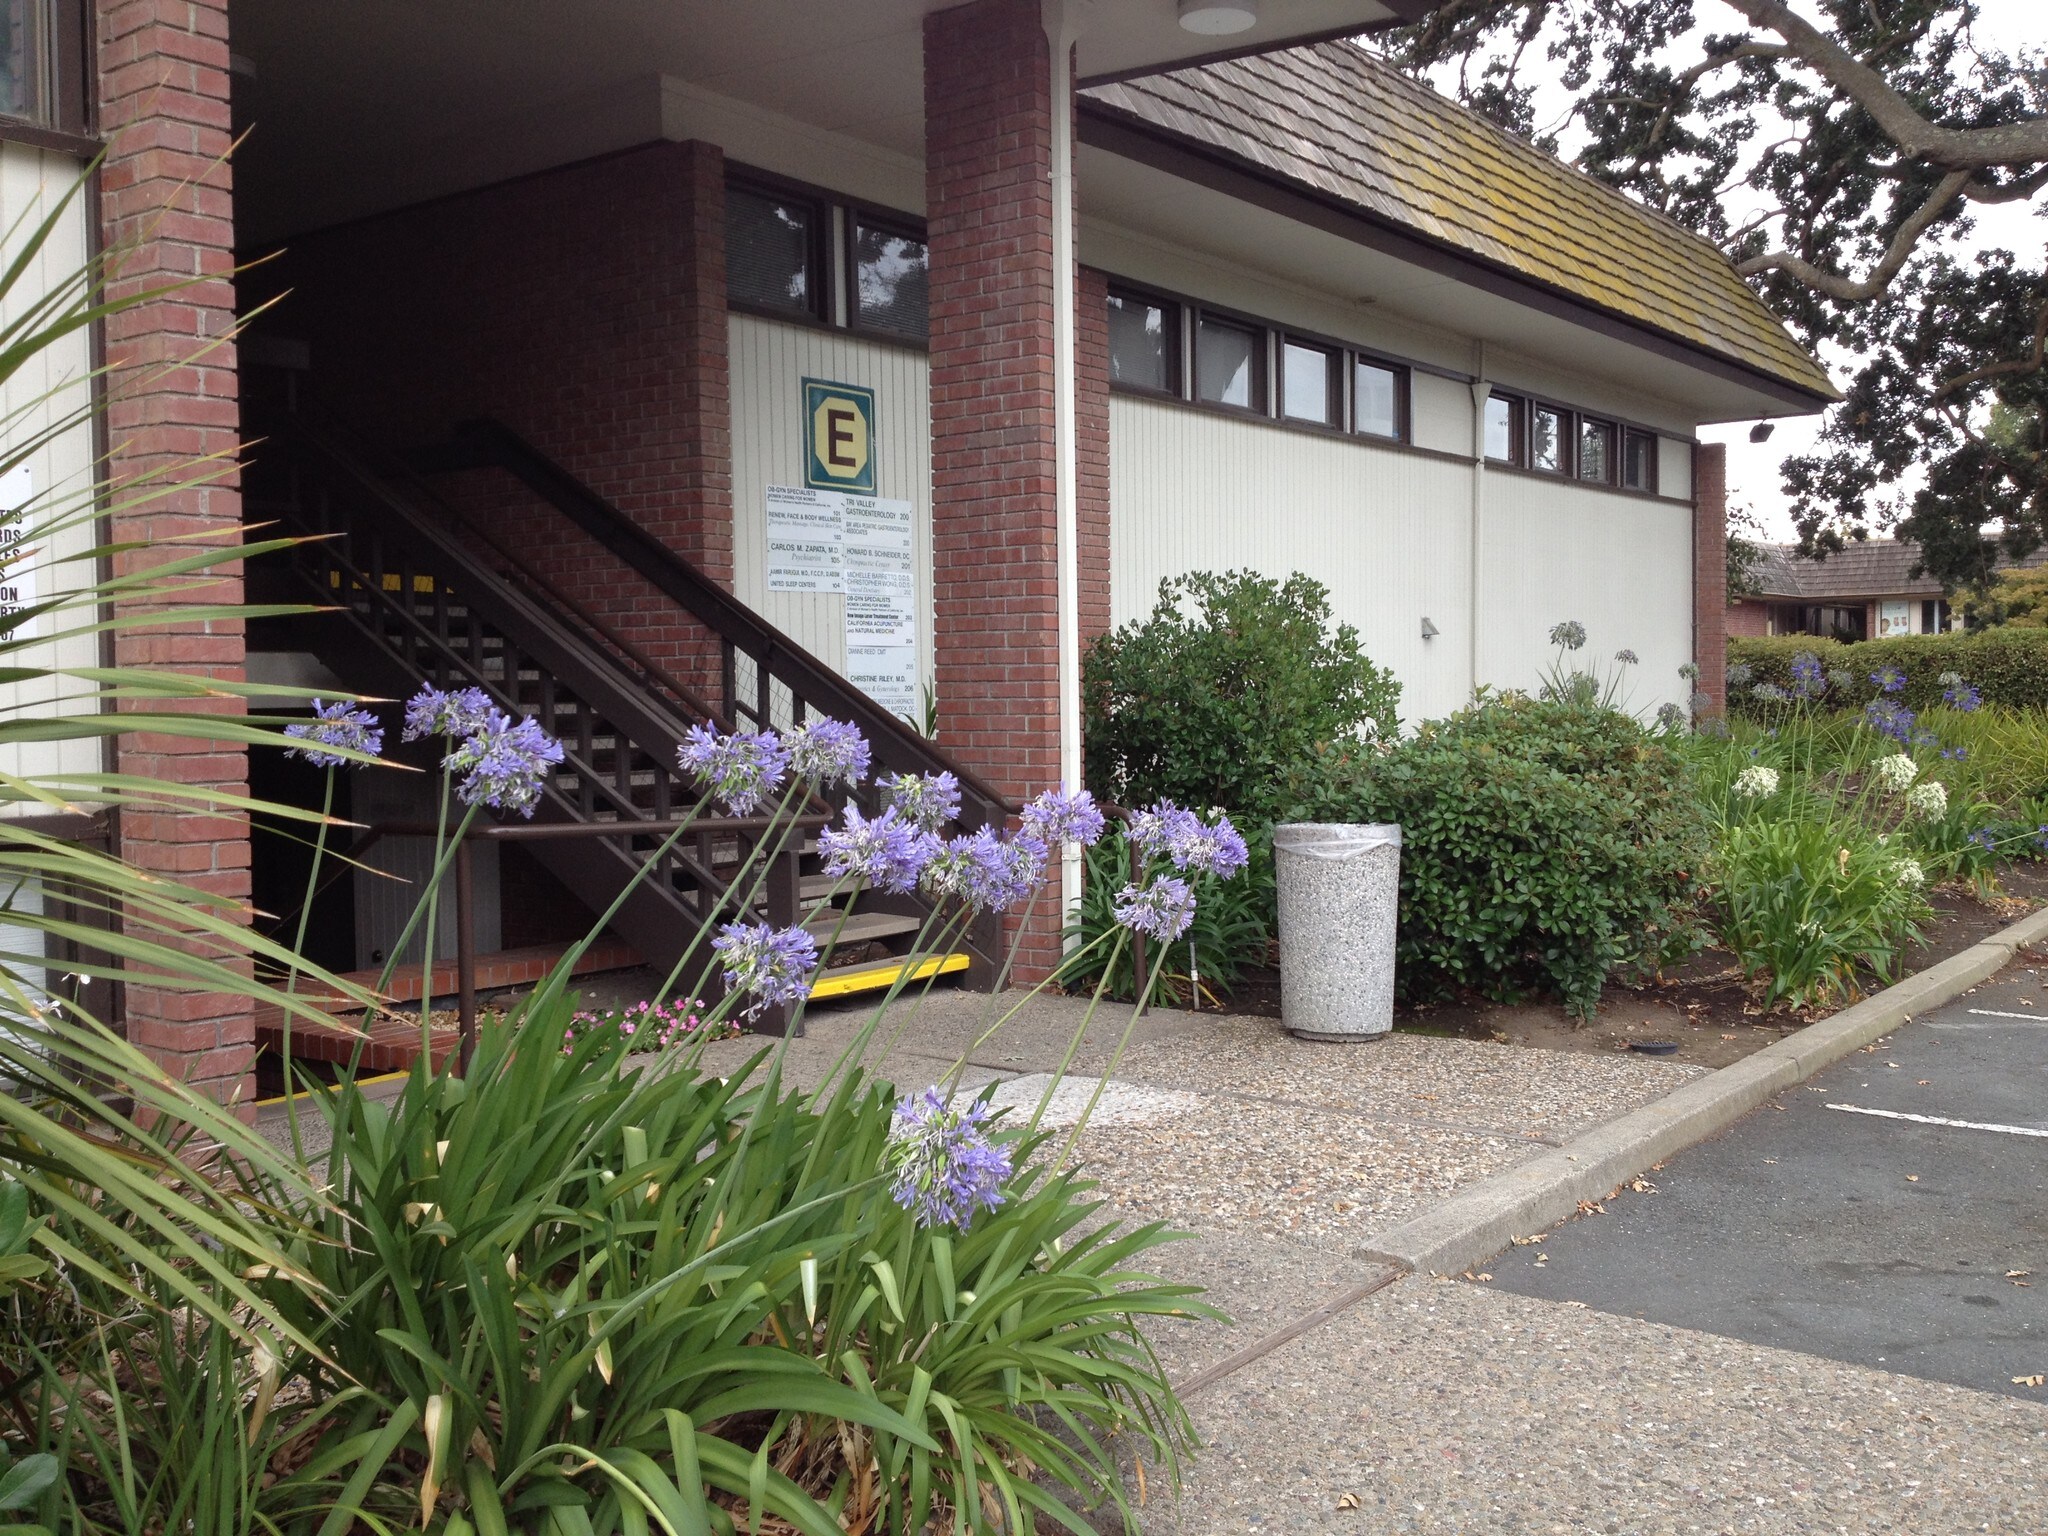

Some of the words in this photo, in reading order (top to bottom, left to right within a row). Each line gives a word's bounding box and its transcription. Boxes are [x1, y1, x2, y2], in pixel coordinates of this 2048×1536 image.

[828, 408, 856, 467] E
[787, 488, 816, 496] SPECIALISTS
[856, 500, 875, 508] VALLEY
[846, 507, 896, 519] GASTROENTEROLOGY
[771, 543, 795, 552] CARLOS
[847, 578, 881, 587] CHRISTOPHER
[1, 587, 17, 601] ON
